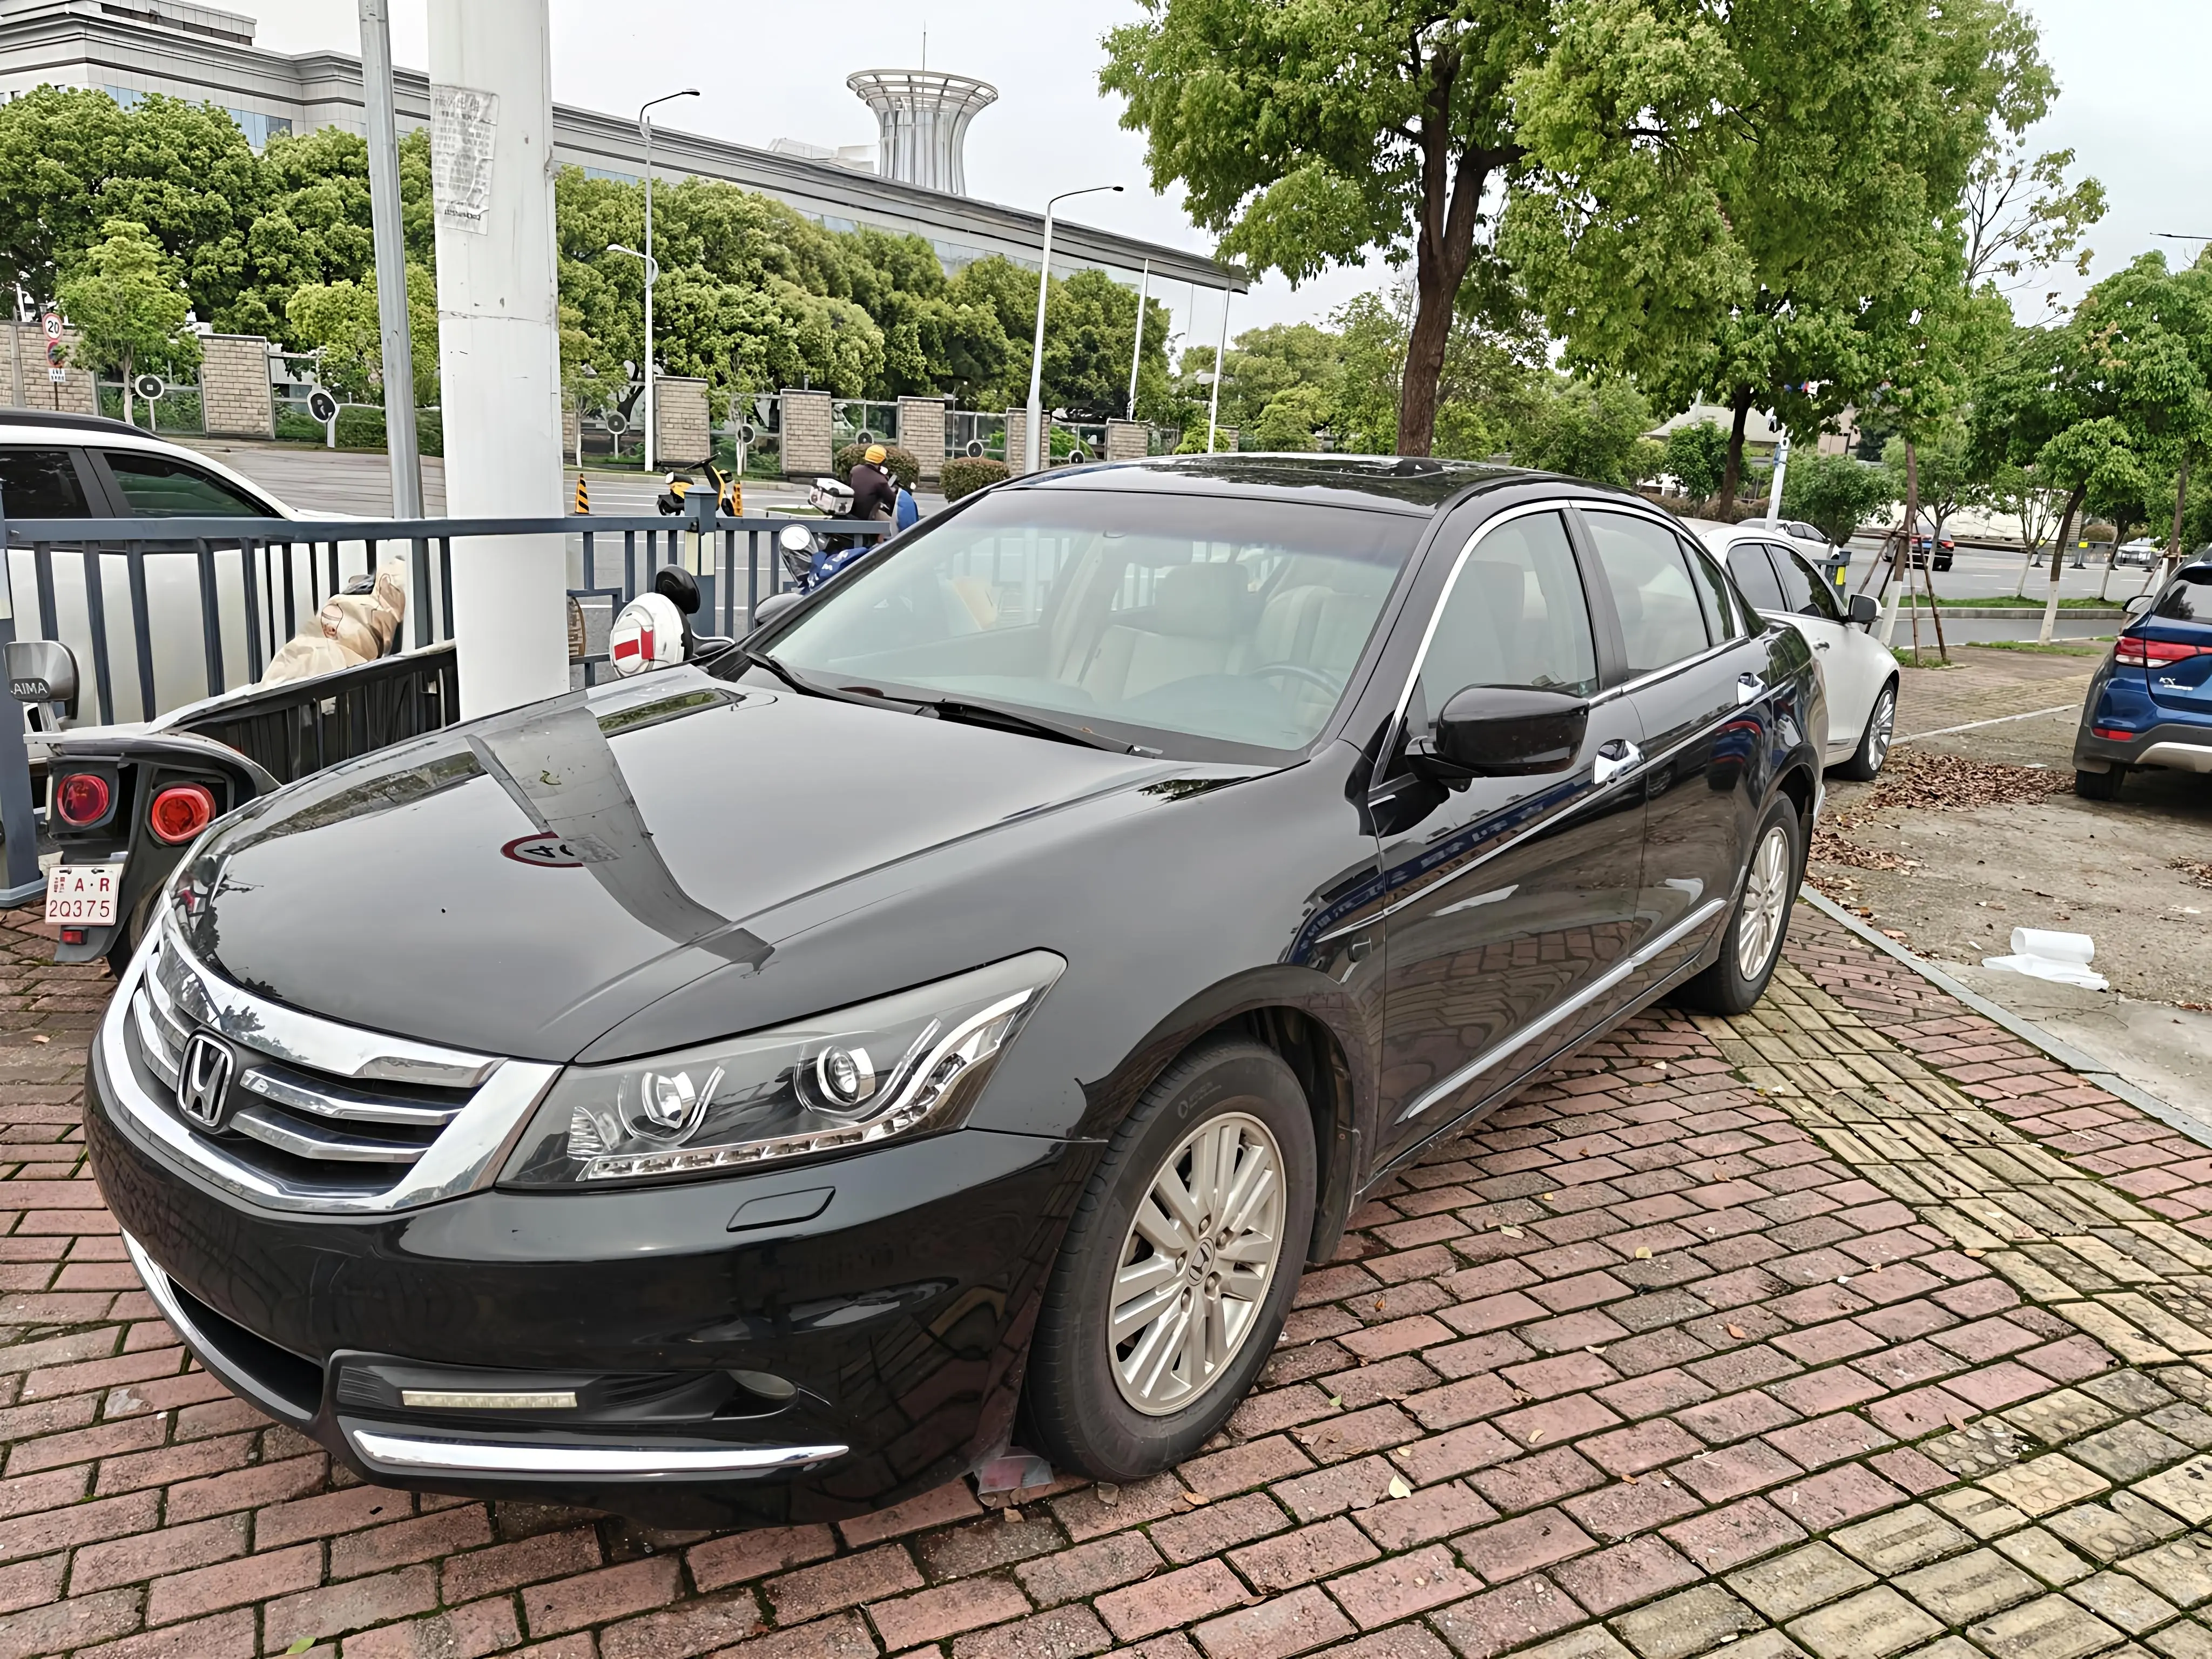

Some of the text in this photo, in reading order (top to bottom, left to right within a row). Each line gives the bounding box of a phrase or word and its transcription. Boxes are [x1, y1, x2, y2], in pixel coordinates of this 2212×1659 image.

[48, 320, 59, 334] 20
[14, 682, 48, 694] AIMA
[49, 900, 110, 918] 2Q375
